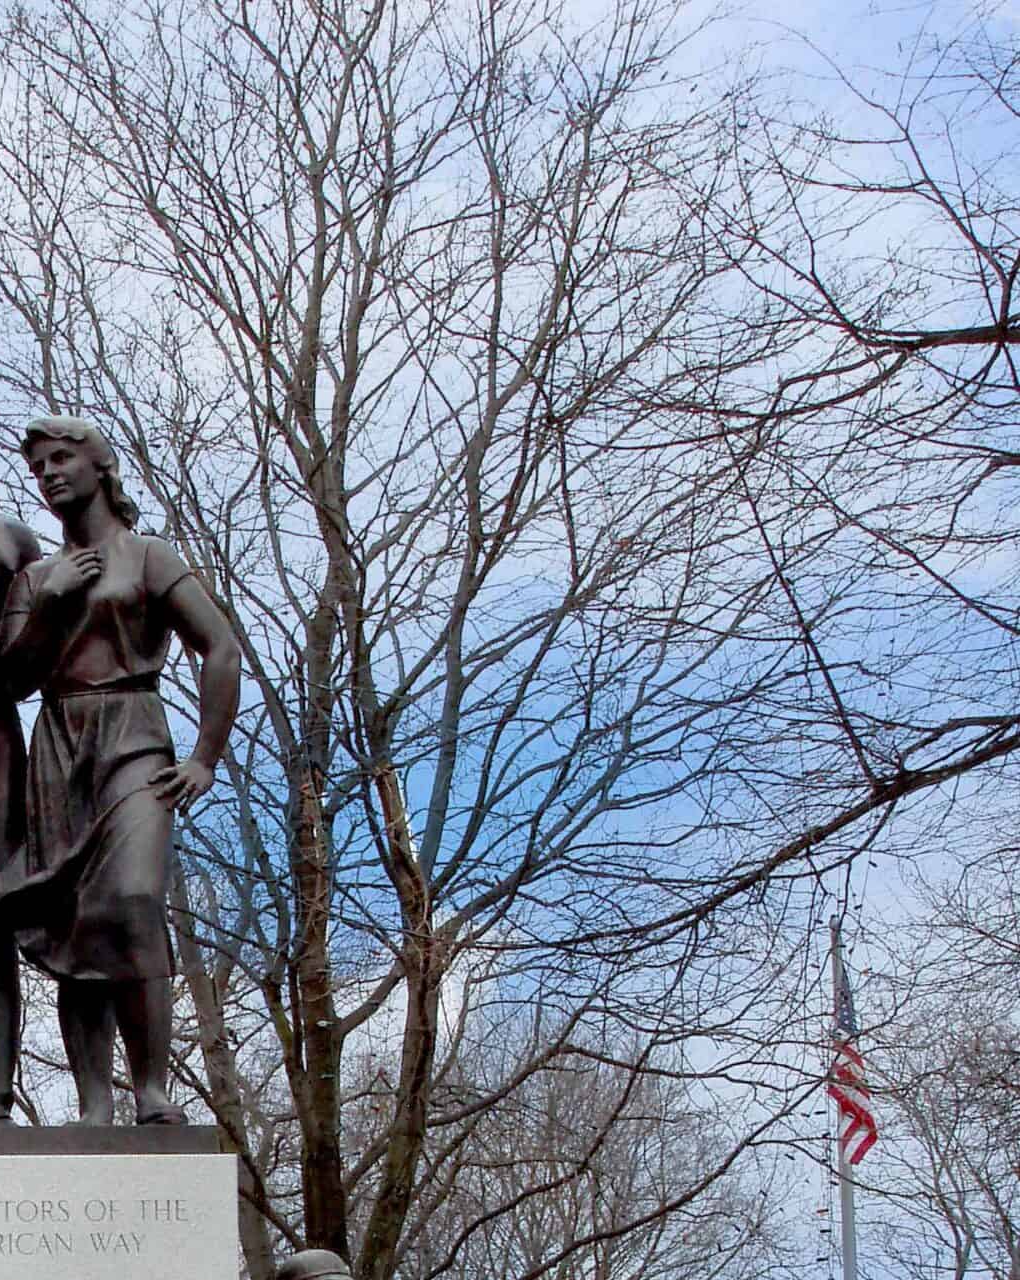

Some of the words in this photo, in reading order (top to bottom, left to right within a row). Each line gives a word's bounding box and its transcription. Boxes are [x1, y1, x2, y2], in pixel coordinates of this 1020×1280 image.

[84, 1199, 124, 1222] OF
[140, 1199, 189, 1222] THE
[89, 1231, 146, 1253] WAY
